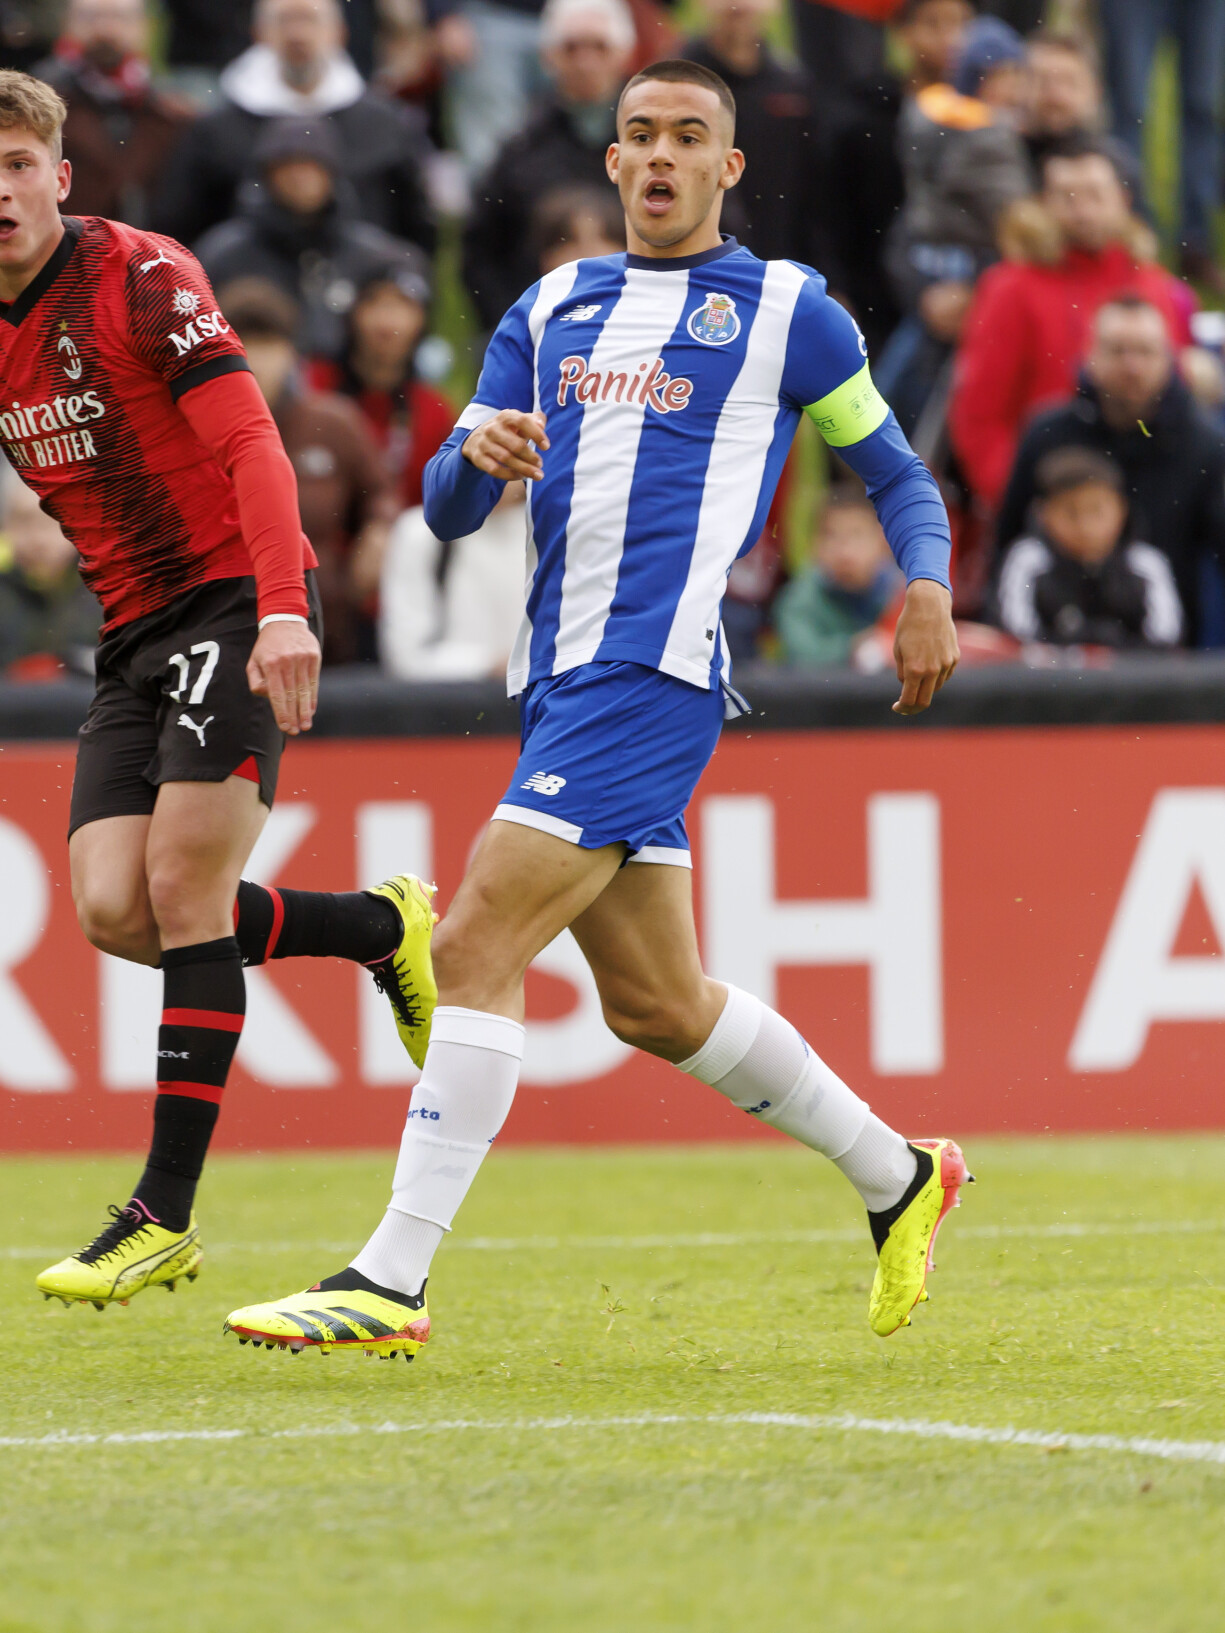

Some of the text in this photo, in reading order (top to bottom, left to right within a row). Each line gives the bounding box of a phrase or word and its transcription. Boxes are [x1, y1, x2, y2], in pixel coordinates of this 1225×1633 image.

[167, 311, 230, 356] MSC
[557, 355, 694, 414] Panike
[31, 430, 98, 468] BETTER
[168, 640, 220, 705] 17
